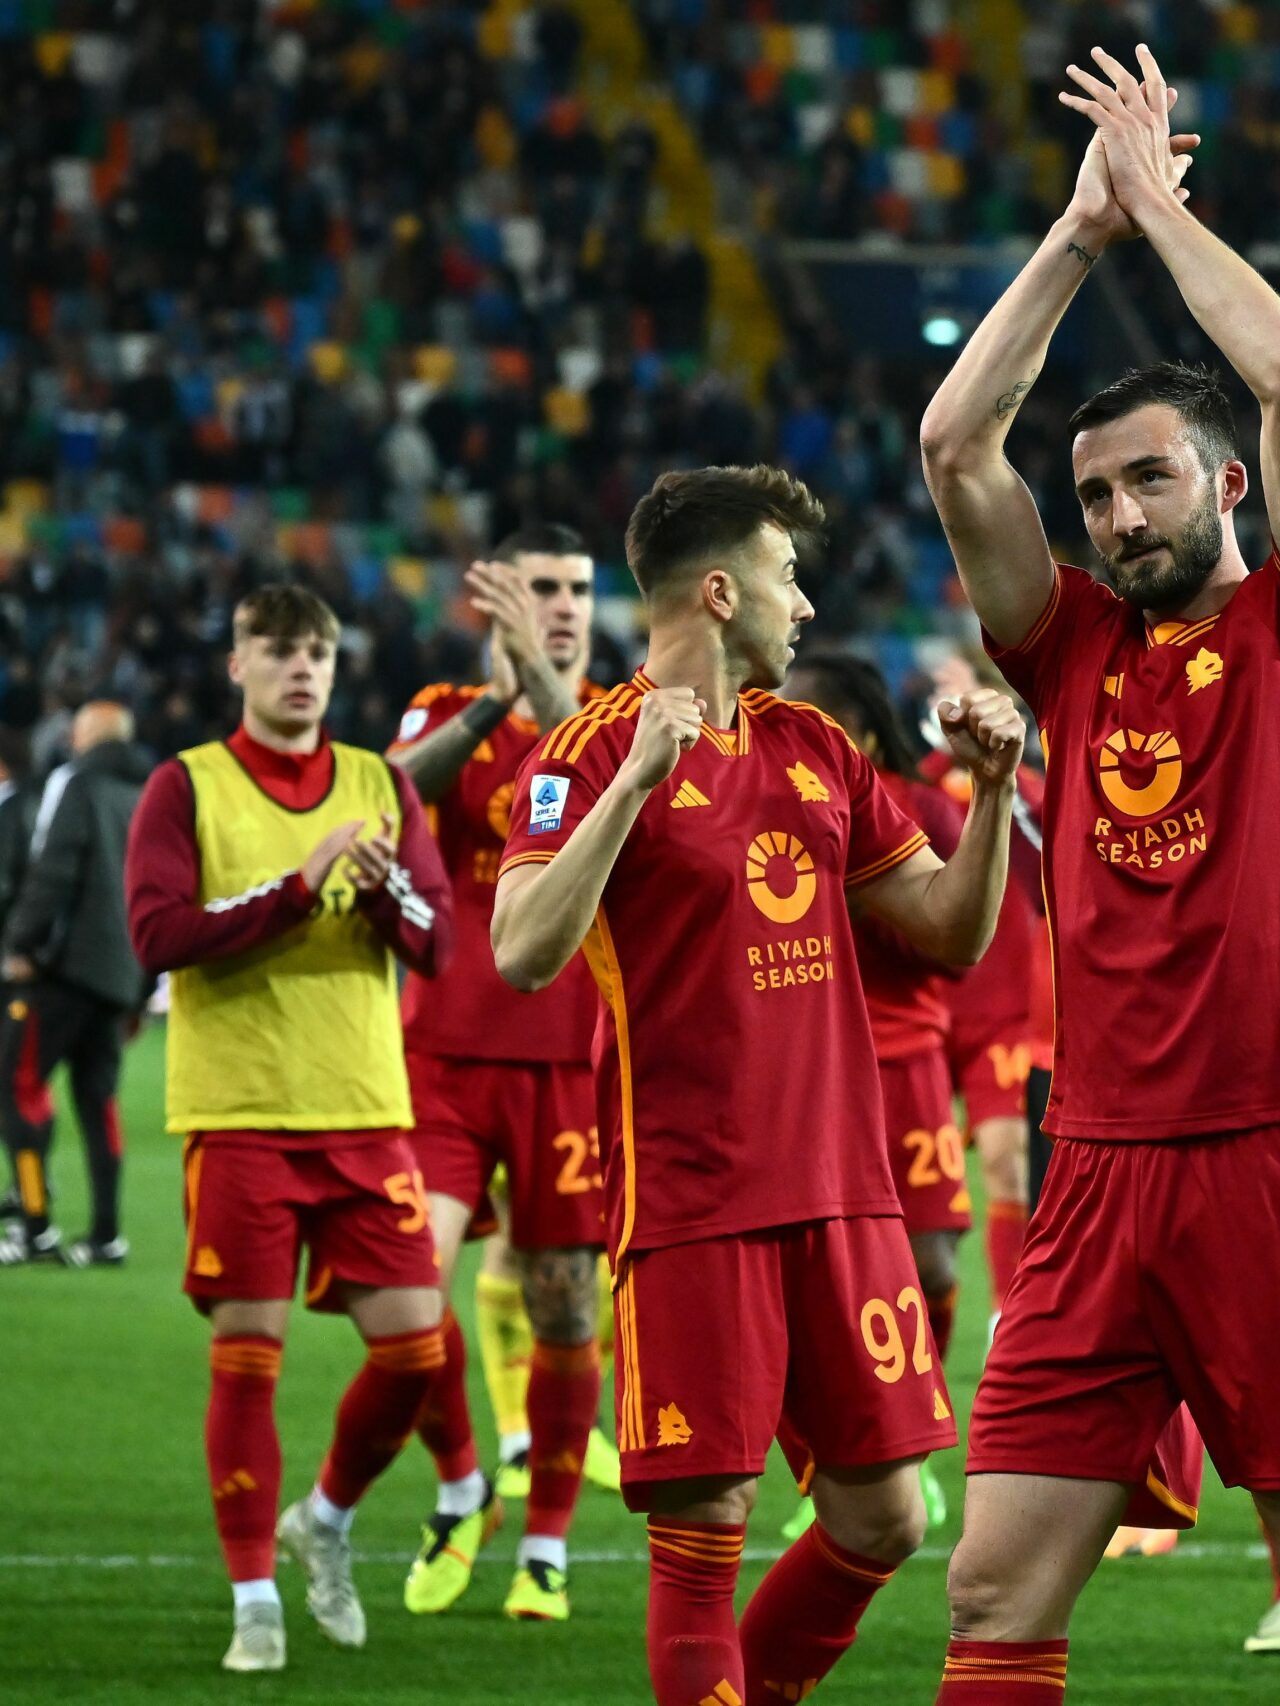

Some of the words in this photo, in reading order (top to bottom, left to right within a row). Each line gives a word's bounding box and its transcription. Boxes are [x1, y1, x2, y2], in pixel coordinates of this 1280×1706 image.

[535, 808, 550, 816] SERIE
[541, 820, 556, 830] TIM
[1094, 808, 1205, 852] RYADH
[1096, 833, 1207, 869] SEASON
[747, 935, 832, 967] RIYADH
[753, 960, 834, 991] SEASON
[902, 1123, 965, 1188] 20
[860, 1286, 933, 1384] 92
